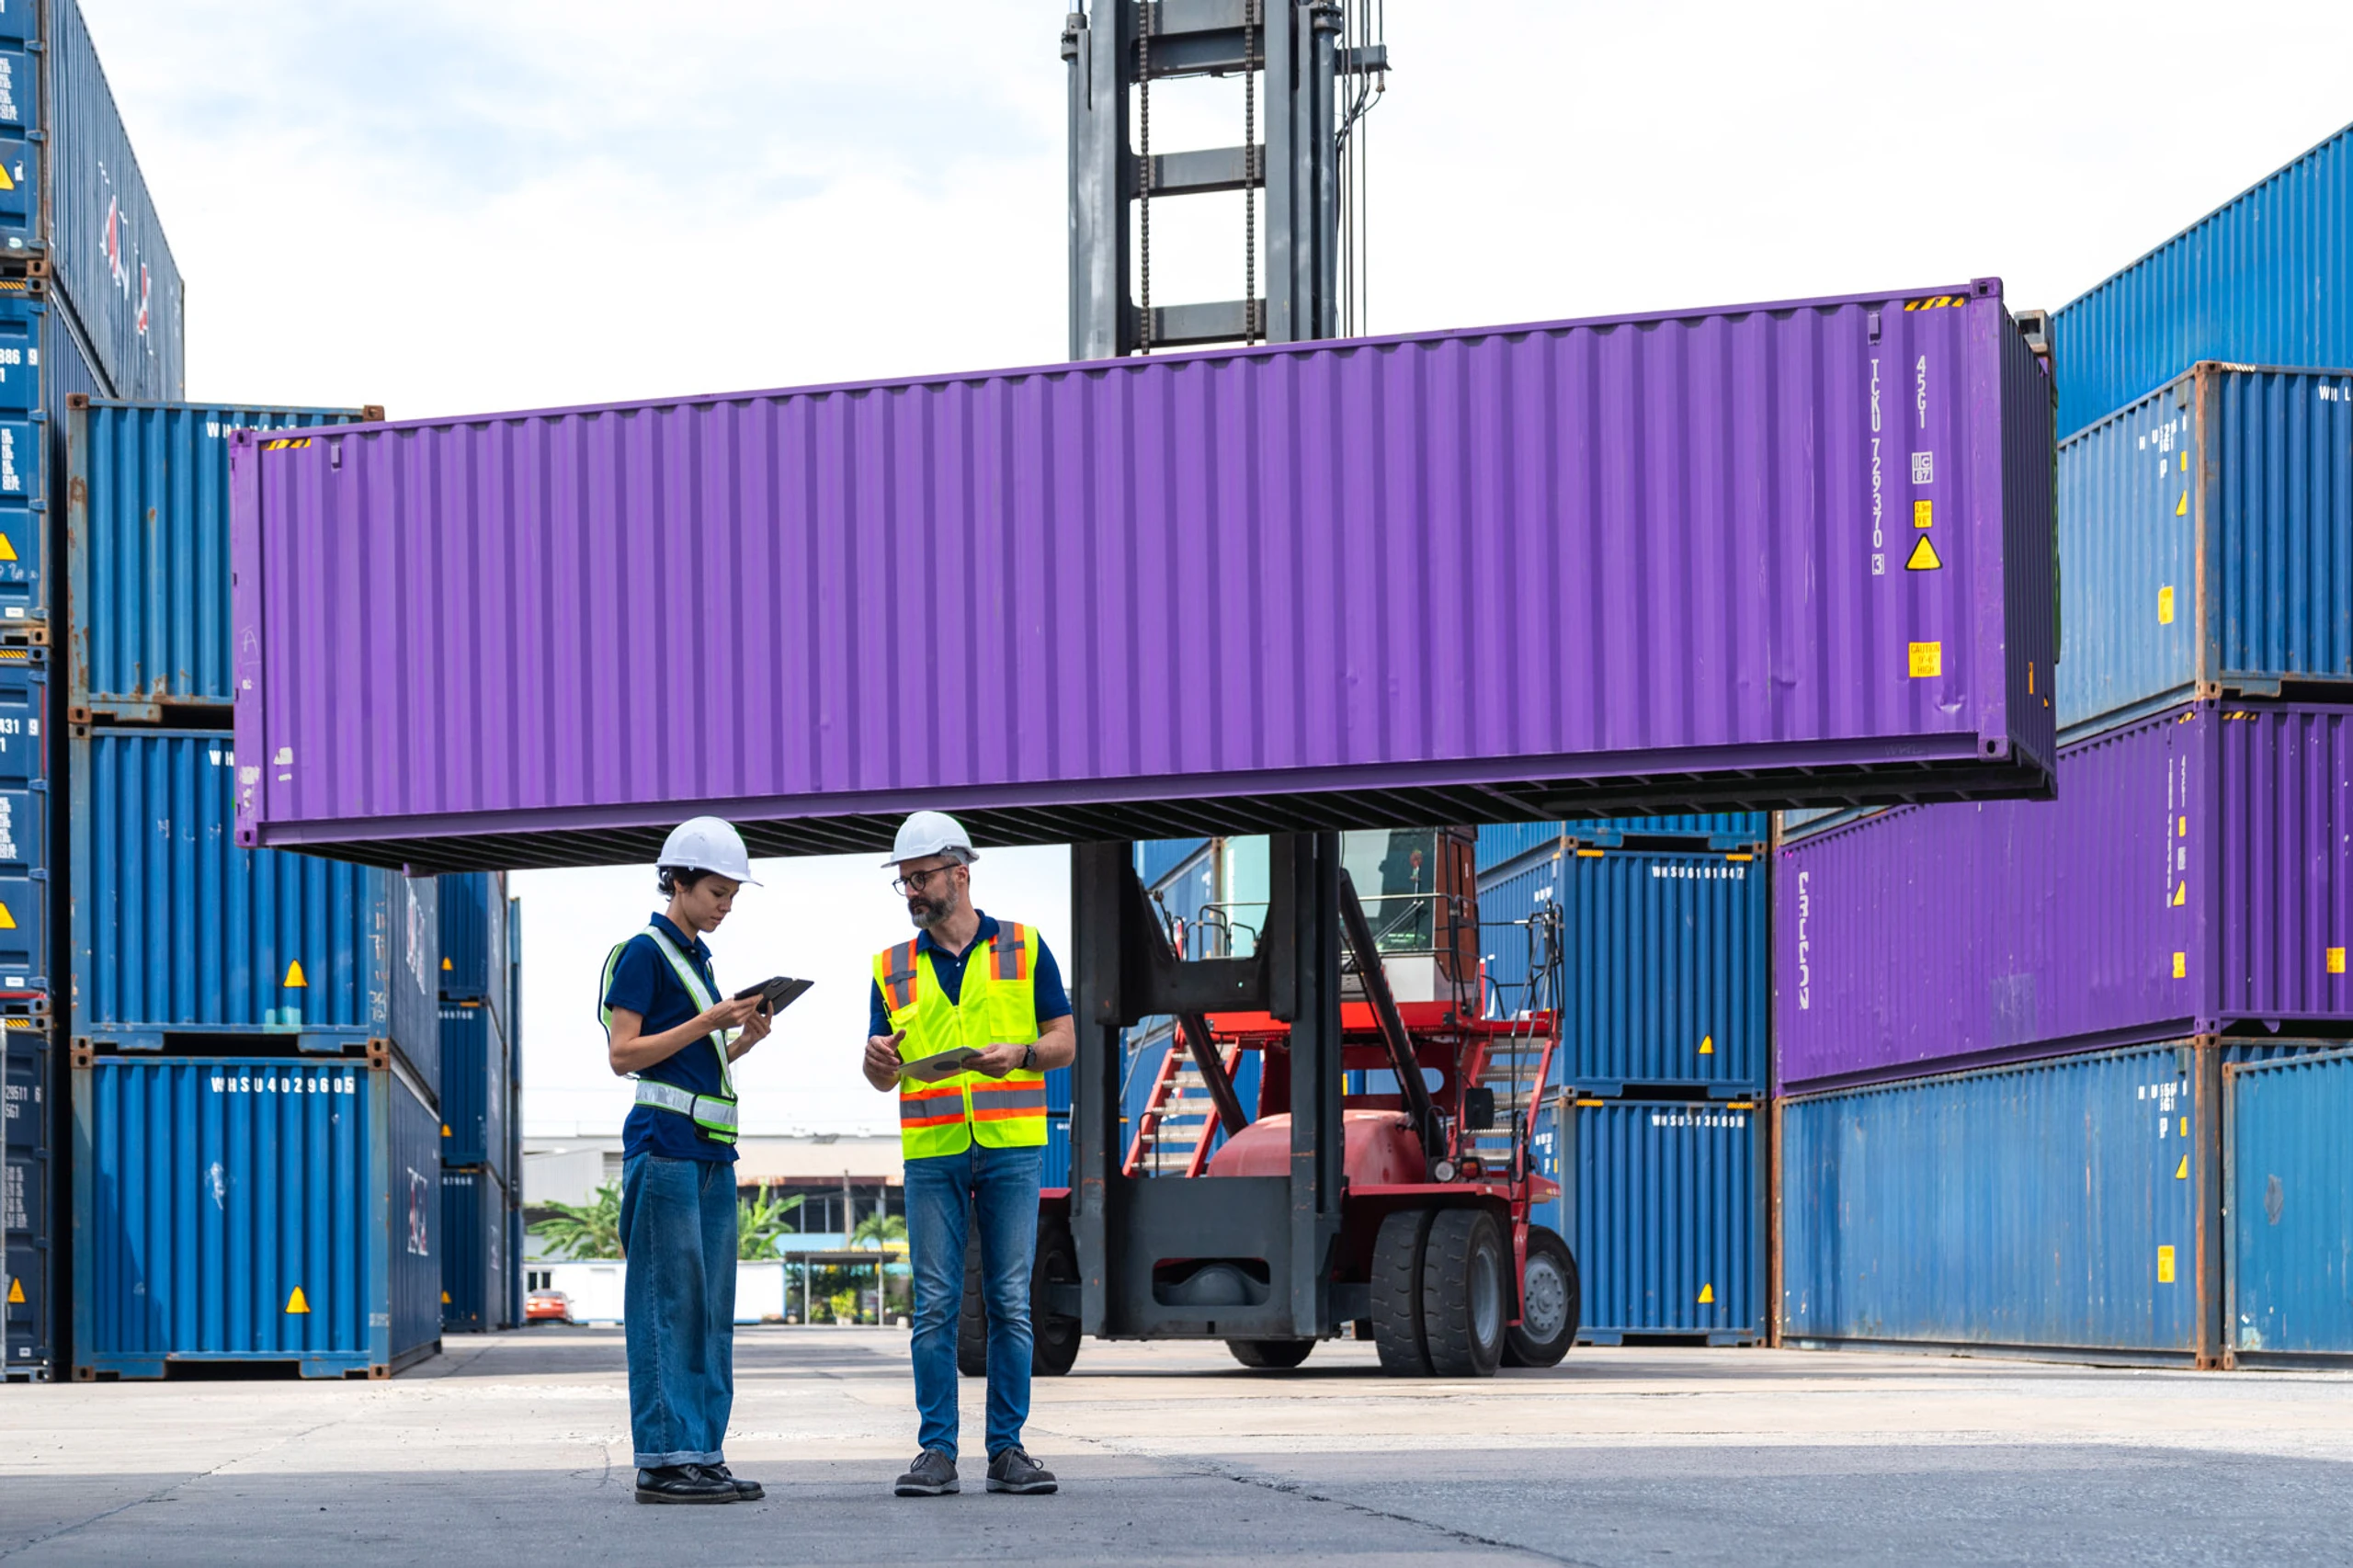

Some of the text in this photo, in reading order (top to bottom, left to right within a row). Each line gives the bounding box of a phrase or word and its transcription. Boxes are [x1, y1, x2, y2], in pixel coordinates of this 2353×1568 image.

[1916, 356, 1927, 429] 45G1
[1871, 359, 1884, 574] TCKU 729370 3
[1910, 644, 1940, 653] CAUTION
[211, 1076, 355, 1094] WHSU4029605
